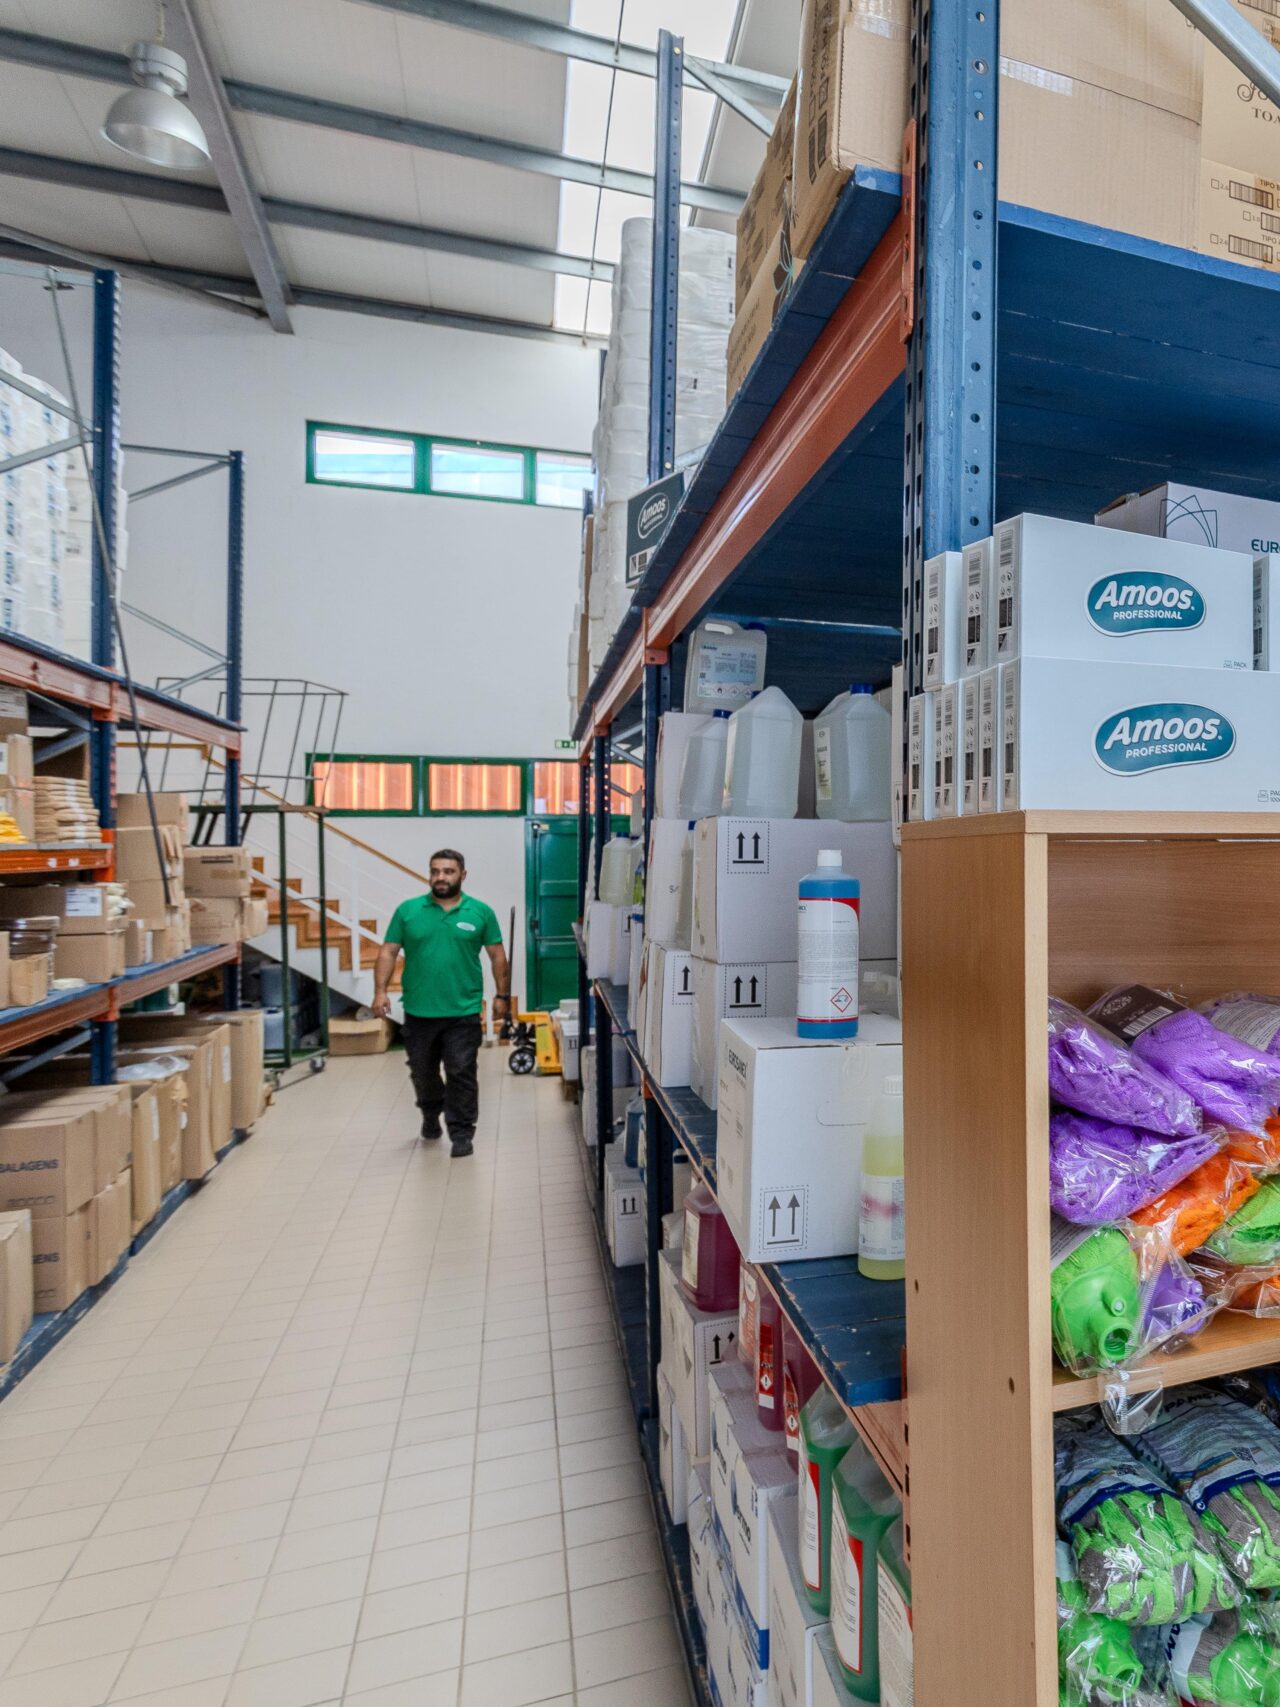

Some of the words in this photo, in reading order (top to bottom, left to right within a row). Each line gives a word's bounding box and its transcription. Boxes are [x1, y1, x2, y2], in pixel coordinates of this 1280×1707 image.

[1259, 179, 1276, 189] TIPO
[1262, 234, 1278, 245] TIPO
[1112, 609, 1183, 620] PROFESSIONAL
[1125, 743, 1208, 759] PROFESSIONAL
